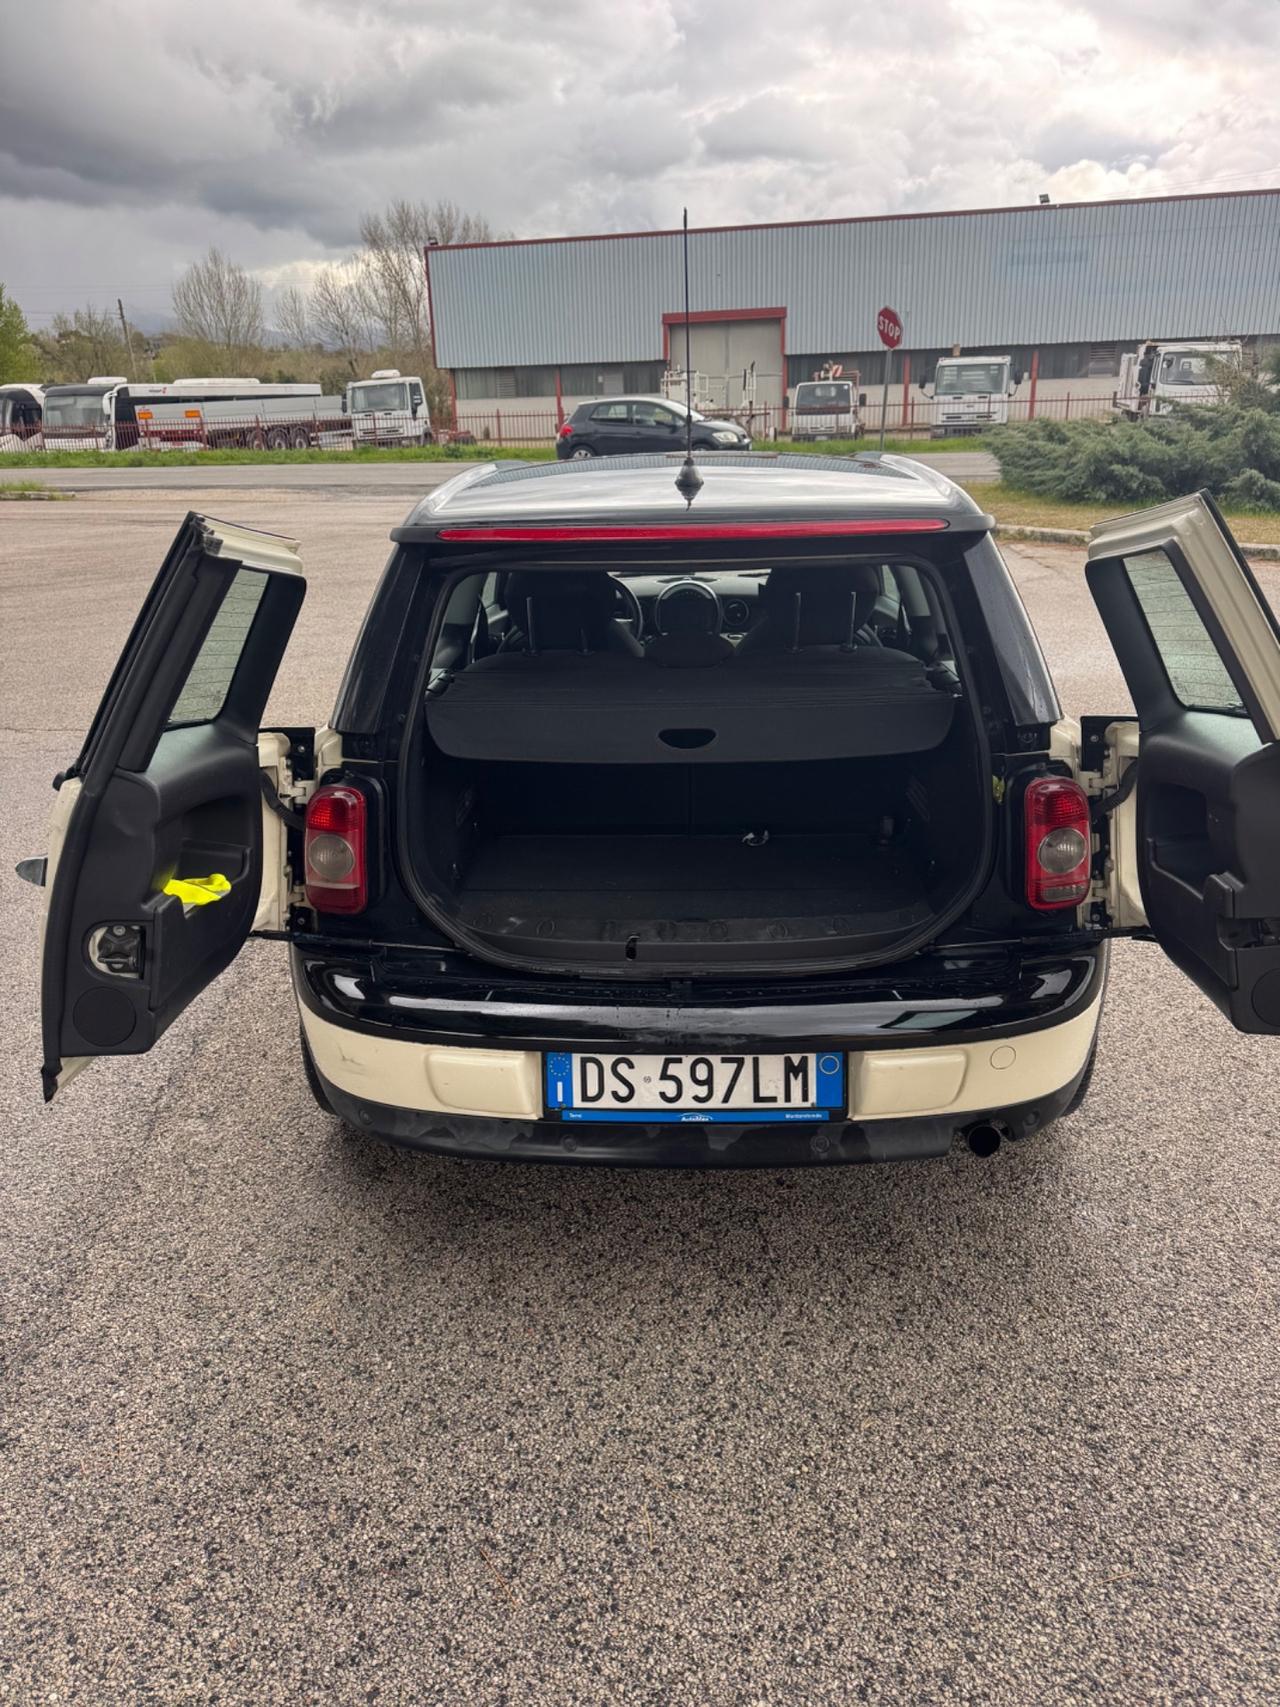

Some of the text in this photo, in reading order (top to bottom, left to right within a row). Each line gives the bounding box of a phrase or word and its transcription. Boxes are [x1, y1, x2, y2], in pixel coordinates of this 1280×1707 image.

[878, 315, 900, 340] STOP
[580, 1057, 635, 1103] DS
[659, 1056, 809, 1103] 597LM
